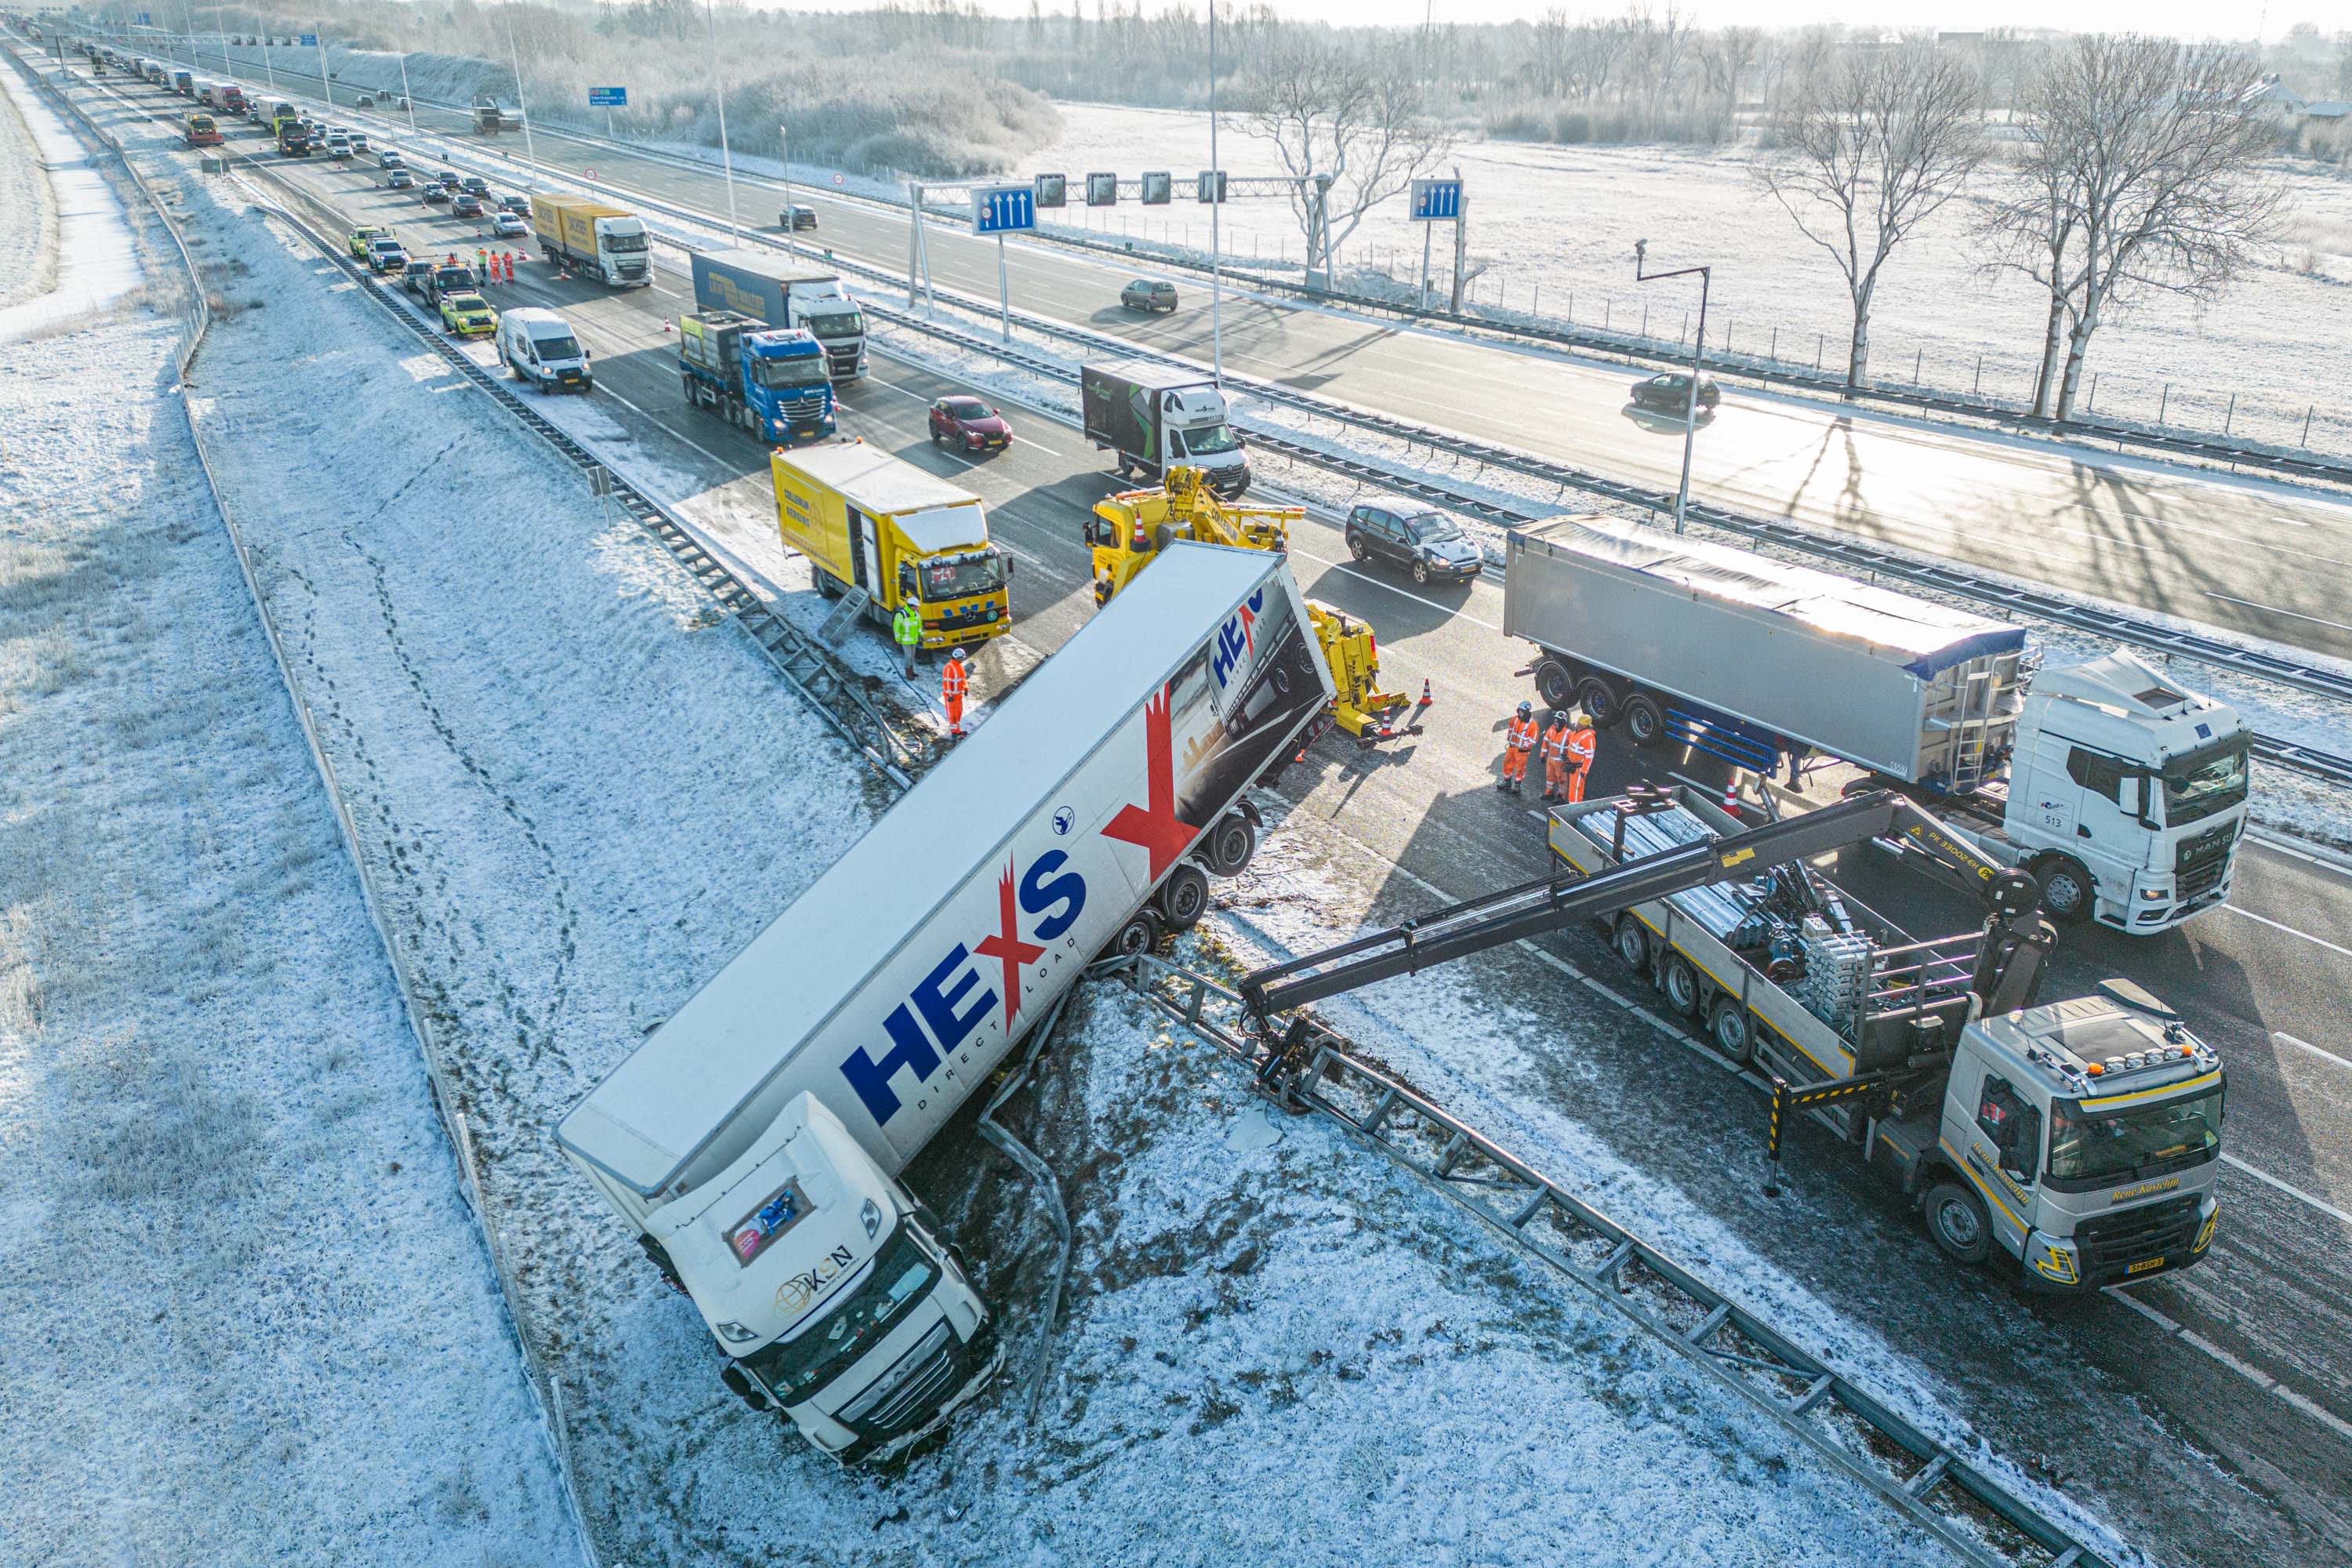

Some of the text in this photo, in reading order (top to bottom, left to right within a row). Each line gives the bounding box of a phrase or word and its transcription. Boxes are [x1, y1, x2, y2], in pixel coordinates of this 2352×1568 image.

[2045, 815, 2062, 828] 513
[1929, 831, 1979, 870] PK 33002-EH
[2196, 832, 2234, 854] MAN 513
[839, 848, 1087, 1127] HEXS
[917, 937, 1075, 1111] DIRECT LOAD
[2112, 1177, 2180, 1201] René Kastelijn
[804, 1244, 854, 1292] KSN
